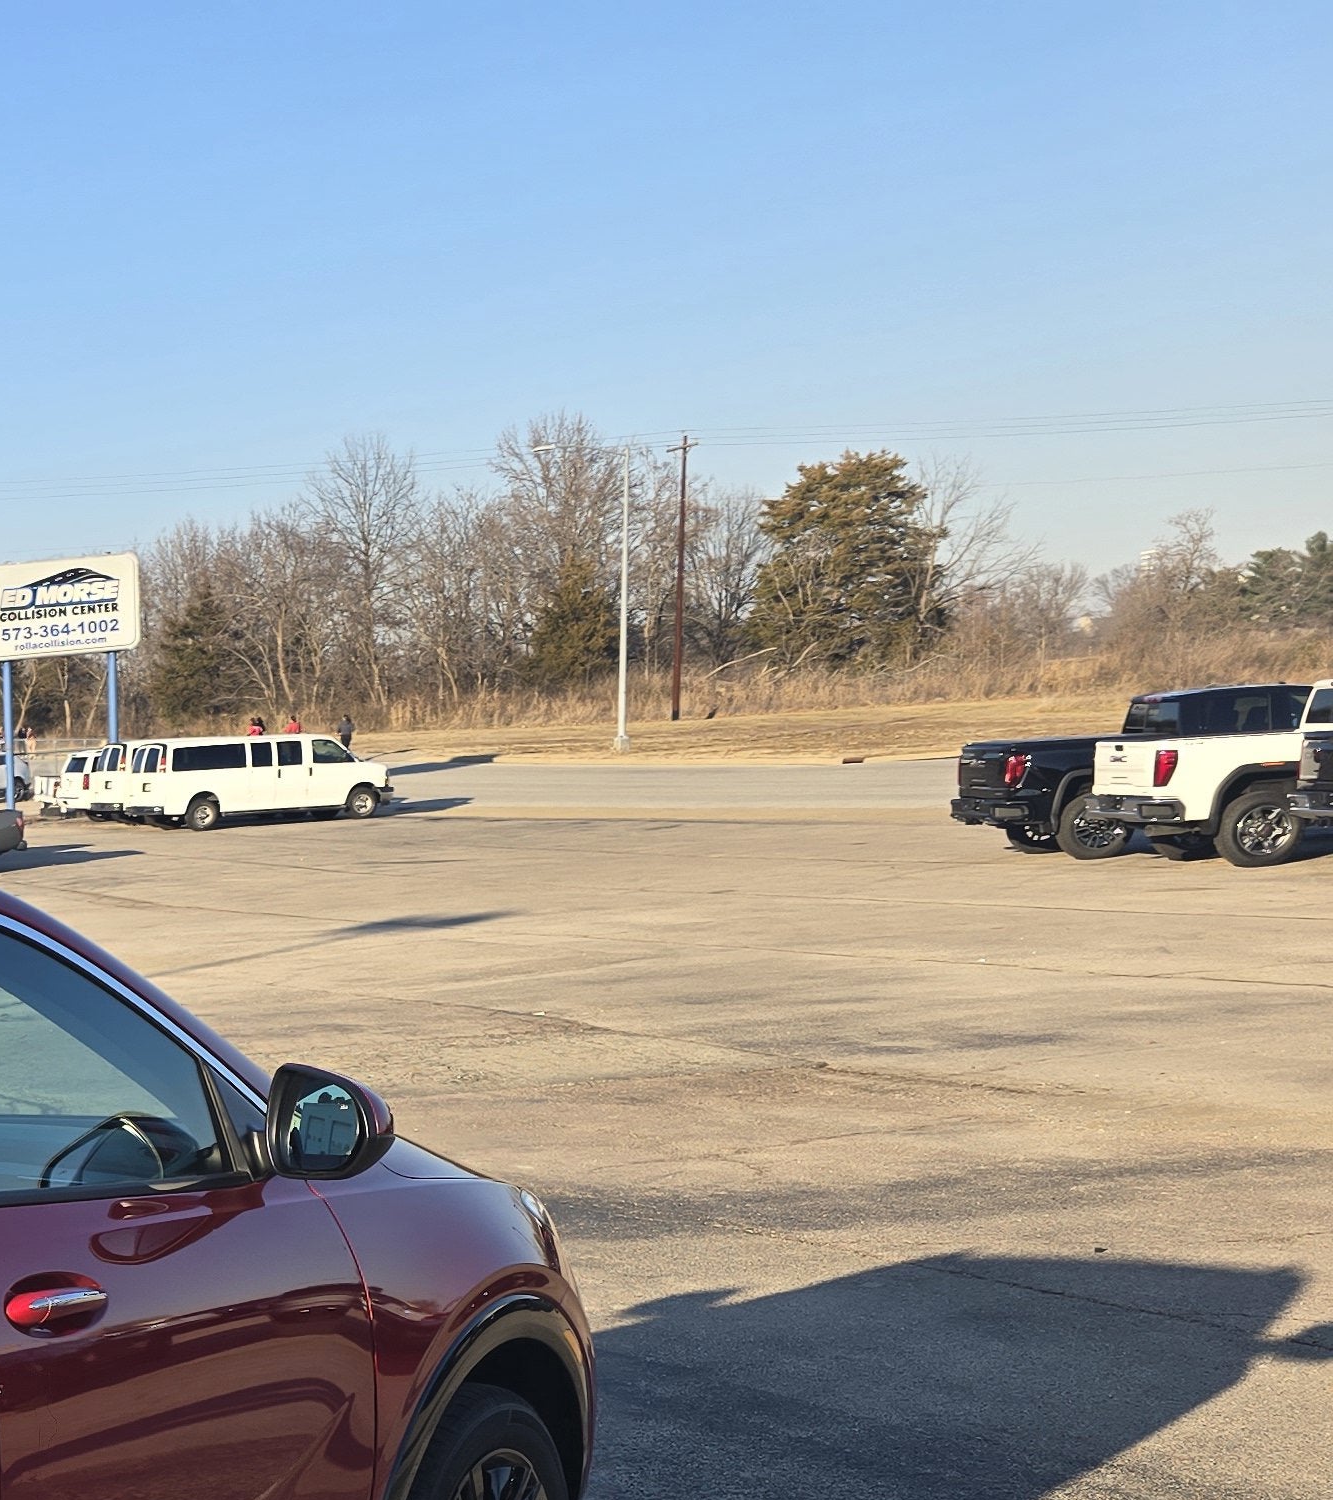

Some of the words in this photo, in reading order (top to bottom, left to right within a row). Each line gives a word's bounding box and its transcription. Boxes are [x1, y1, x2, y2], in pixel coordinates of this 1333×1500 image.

[1, 587, 33, 611] ED
[35, 579, 119, 608] MORSE
[0, 606, 67, 622] COLLISION
[71, 602, 120, 616] CENTER
[1, 618, 120, 642] 573-364-1002
[14, 636, 107, 651] rollacollision.com
